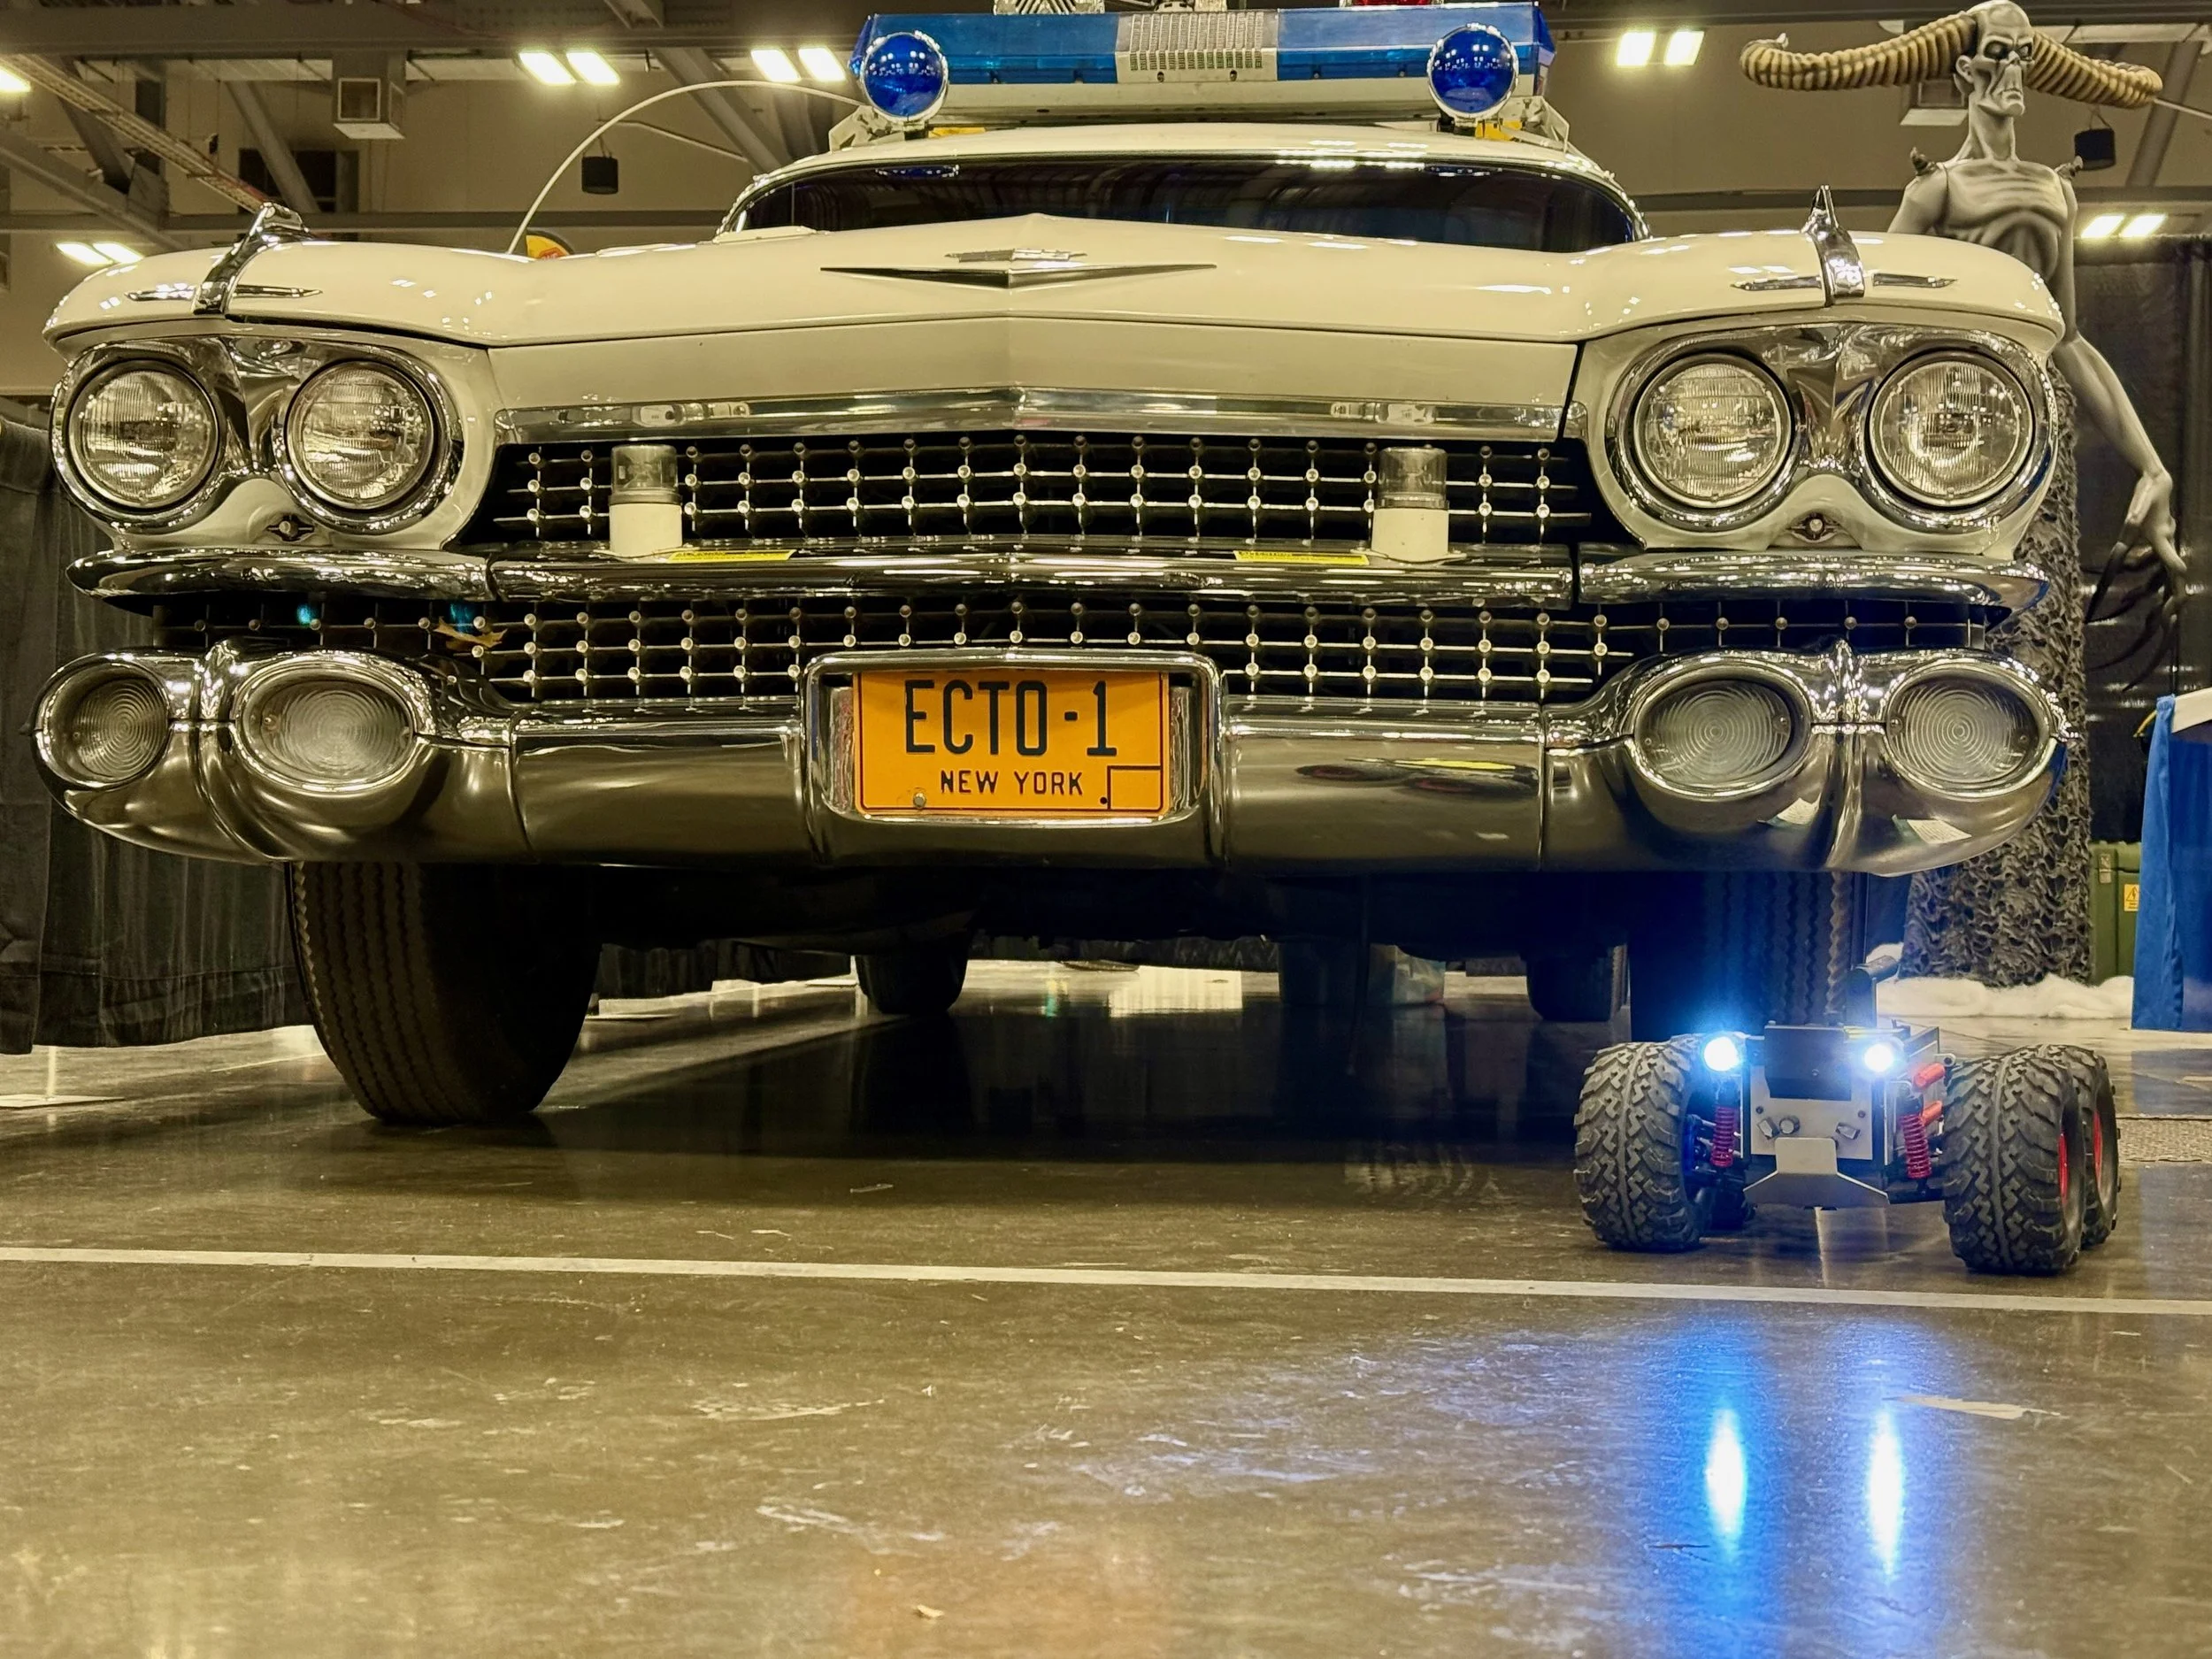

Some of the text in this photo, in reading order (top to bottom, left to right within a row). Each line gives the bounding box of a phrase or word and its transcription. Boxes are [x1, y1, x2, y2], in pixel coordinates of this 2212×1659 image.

[905, 679, 1118, 757] ECTO-1
[941, 770, 1083, 795] NEW YORK
